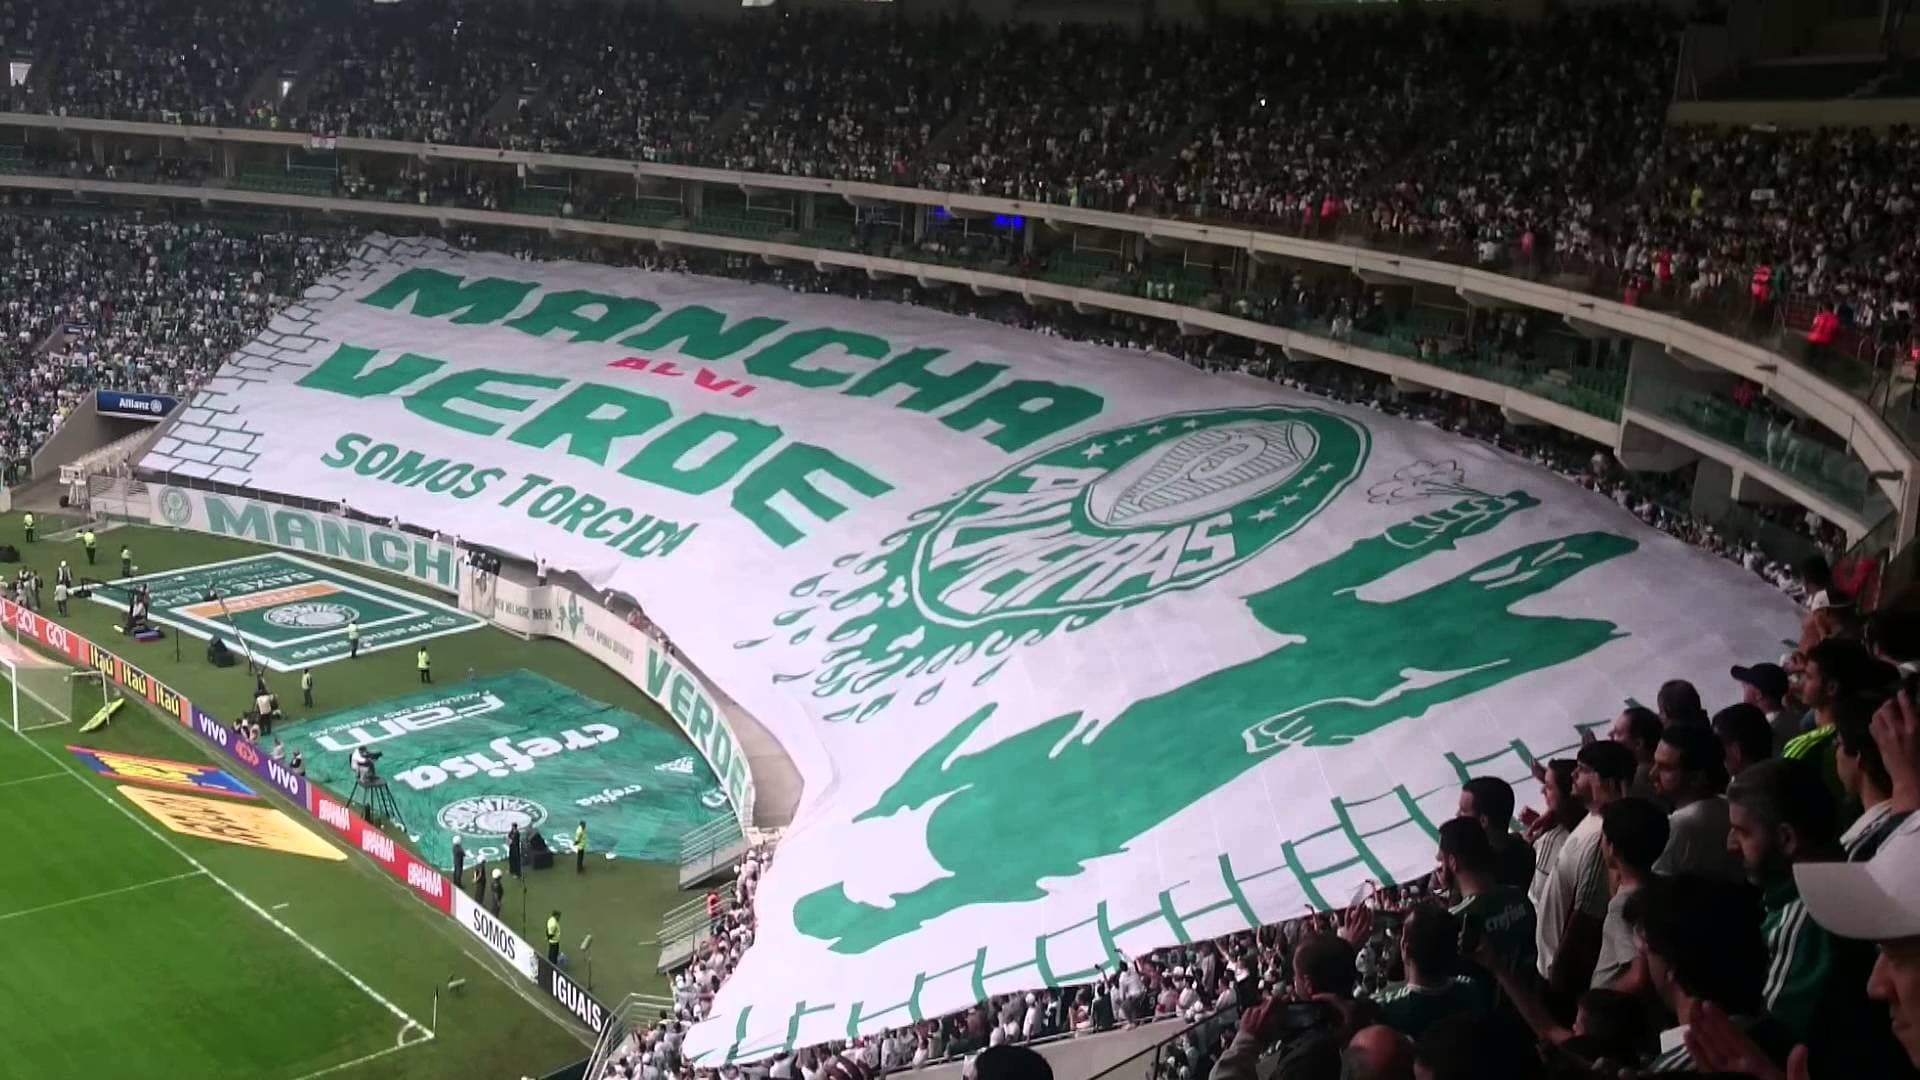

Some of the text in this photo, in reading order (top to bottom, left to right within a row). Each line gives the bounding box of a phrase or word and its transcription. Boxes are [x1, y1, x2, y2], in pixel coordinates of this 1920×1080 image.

[359, 267, 1104, 453] MANCHA
[119, 397, 149, 411] Allianz
[295, 342, 895, 549] VERDE
[320, 432, 507, 499] SOMOS
[17, 606, 39, 637] GOL
[46, 623, 71, 653] GOL
[90, 644, 180, 716] Itaú Itaú Itaú
[394, 723, 620, 790] crefisa
[647, 647, 747, 812] VERDE
[318, 798, 443, 897] BRAHMA BRAHMA BRAHMA
[473, 907, 516, 960] SOMOS
[552, 970, 602, 1033] IGUAIS
